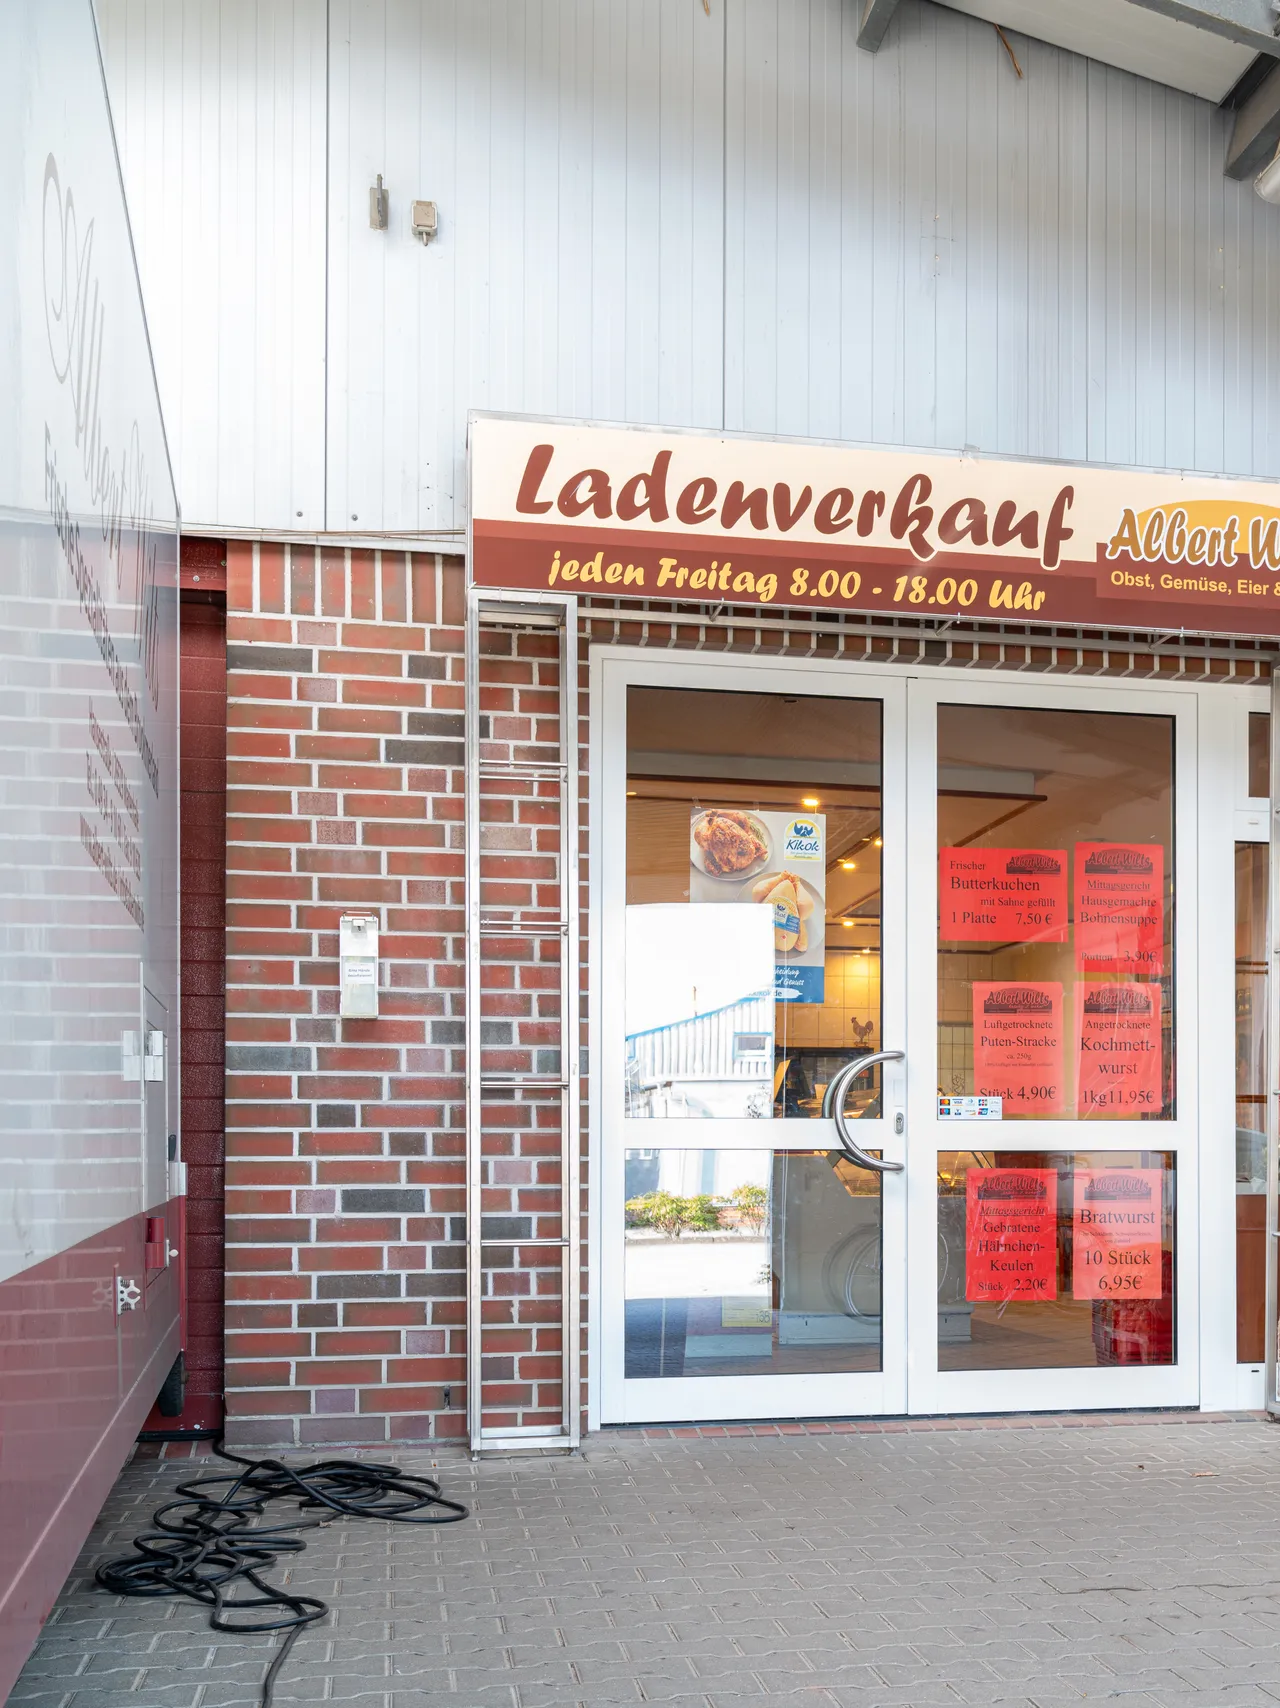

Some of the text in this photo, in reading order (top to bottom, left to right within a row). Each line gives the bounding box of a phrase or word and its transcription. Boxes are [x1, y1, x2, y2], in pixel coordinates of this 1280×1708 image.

[515, 443, 1075, 569] Ladenverkauf
[1106, 508, 1239, 566] Albert
[548, 550, 1046, 612] jeden Freitag 8.00 - 18.00 Uhr
[1110, 570, 1155, 590] Obst,
[1159, 573, 1233, 596] Gemüse,
[1236, 578, 1270, 596] Eier
[786, 839, 820, 852] Kikok
[950, 860, 987, 871] Frischer
[951, 876, 1040, 891] Butterkuchen
[1087, 880, 1151, 892] Mittagsgericht
[980, 897, 1056, 908] mit Sahne gefüllt
[1080, 895, 1157, 908] Hausgemachte
[951, 911, 957, 923] 1
[962, 911, 997, 924] Platte
[1080, 912, 1158, 927] Bohnensuppe
[1081, 950, 1157, 964] Portion 3,90€
[986, 991, 1050, 1006] Albert Wilts
[983, 1020, 1053, 1030] Luftgetrocknete
[1085, 1020, 1151, 1030] Angetrocknete
[980, 1036, 1057, 1048] Puten-Stracke
[1080, 1037, 1156, 1052] Kochmett-
[1017, 1052, 1032, 1061] 250g
[1099, 1062, 1138, 1075] wurst
[980, 1086, 1057, 1101] Stück 4,90€
[1083, 1090, 1155, 1106] 1kg 11,95€
[980, 1176, 1045, 1192] Albert Wilts
[979, 1206, 1045, 1216] Mittagsgericht
[1080, 1208, 1156, 1224] Bratwurst
[983, 1222, 1041, 1233] Gebratene
[978, 1239, 1045, 1252] Hähnchen-
[1085, 1250, 1152, 1265] 10 Stück
[990, 1260, 1034, 1271] Keulen
[978, 1278, 1048, 1292] Stück 2,20€
[1098, 1275, 1143, 1292] 6,95€
